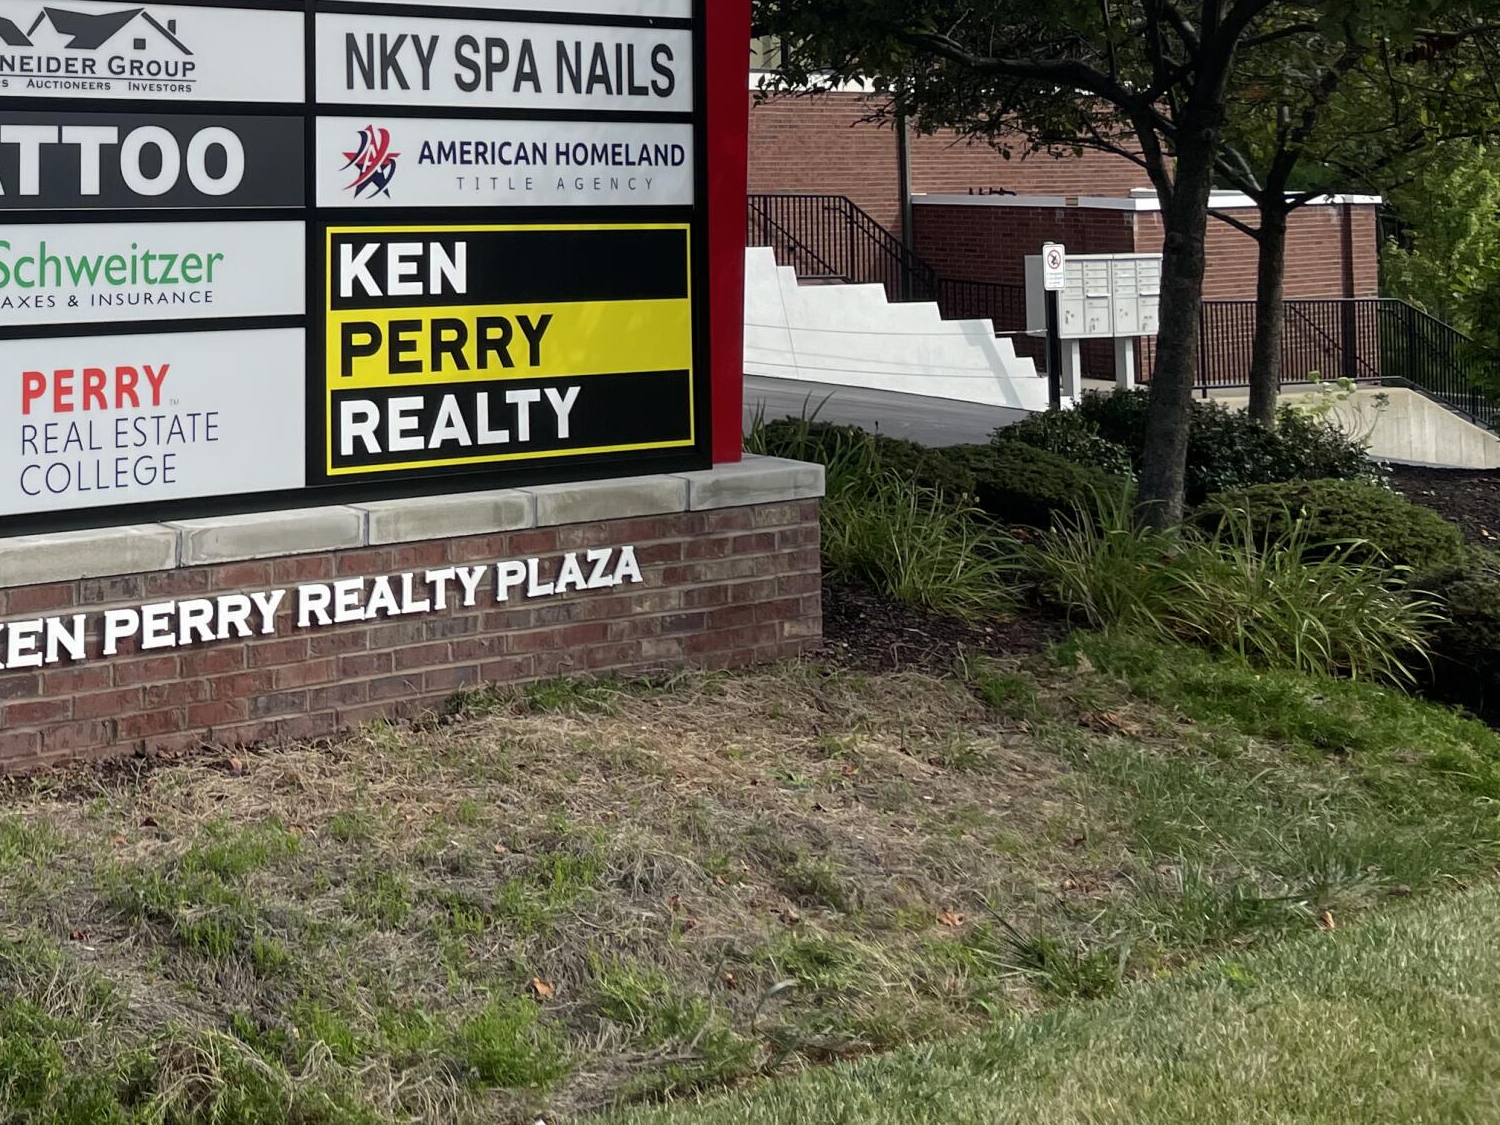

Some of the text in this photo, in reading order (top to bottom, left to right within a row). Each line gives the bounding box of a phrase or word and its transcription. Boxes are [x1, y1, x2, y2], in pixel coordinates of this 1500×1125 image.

[26, 79, 111, 92] AUCTIONEERS
[128, 81, 192, 93] INVESTORS
[107, 56, 196, 78] GROUP
[345, 32, 676, 98] NKY SPA NAILS
[418, 140, 686, 167] AMERICAN HOMELAND
[456, 176, 654, 191] TITLE AGENCY
[339, 241, 467, 298] KEN
[67, 293, 80, 307] &
[91, 290, 214, 307] INSURANCE
[340, 313, 554, 378] PERRY
[21, 363, 171, 415] PERRY
[21, 411, 219, 456] REAL ESTATE
[340, 386, 582, 456] REALTY
[20, 453, 177, 496] COLLEGE
[102, 588, 286, 655] PERRY
[297, 565, 488, 628] REALTY
[496, 545, 643, 603] PLAZA
